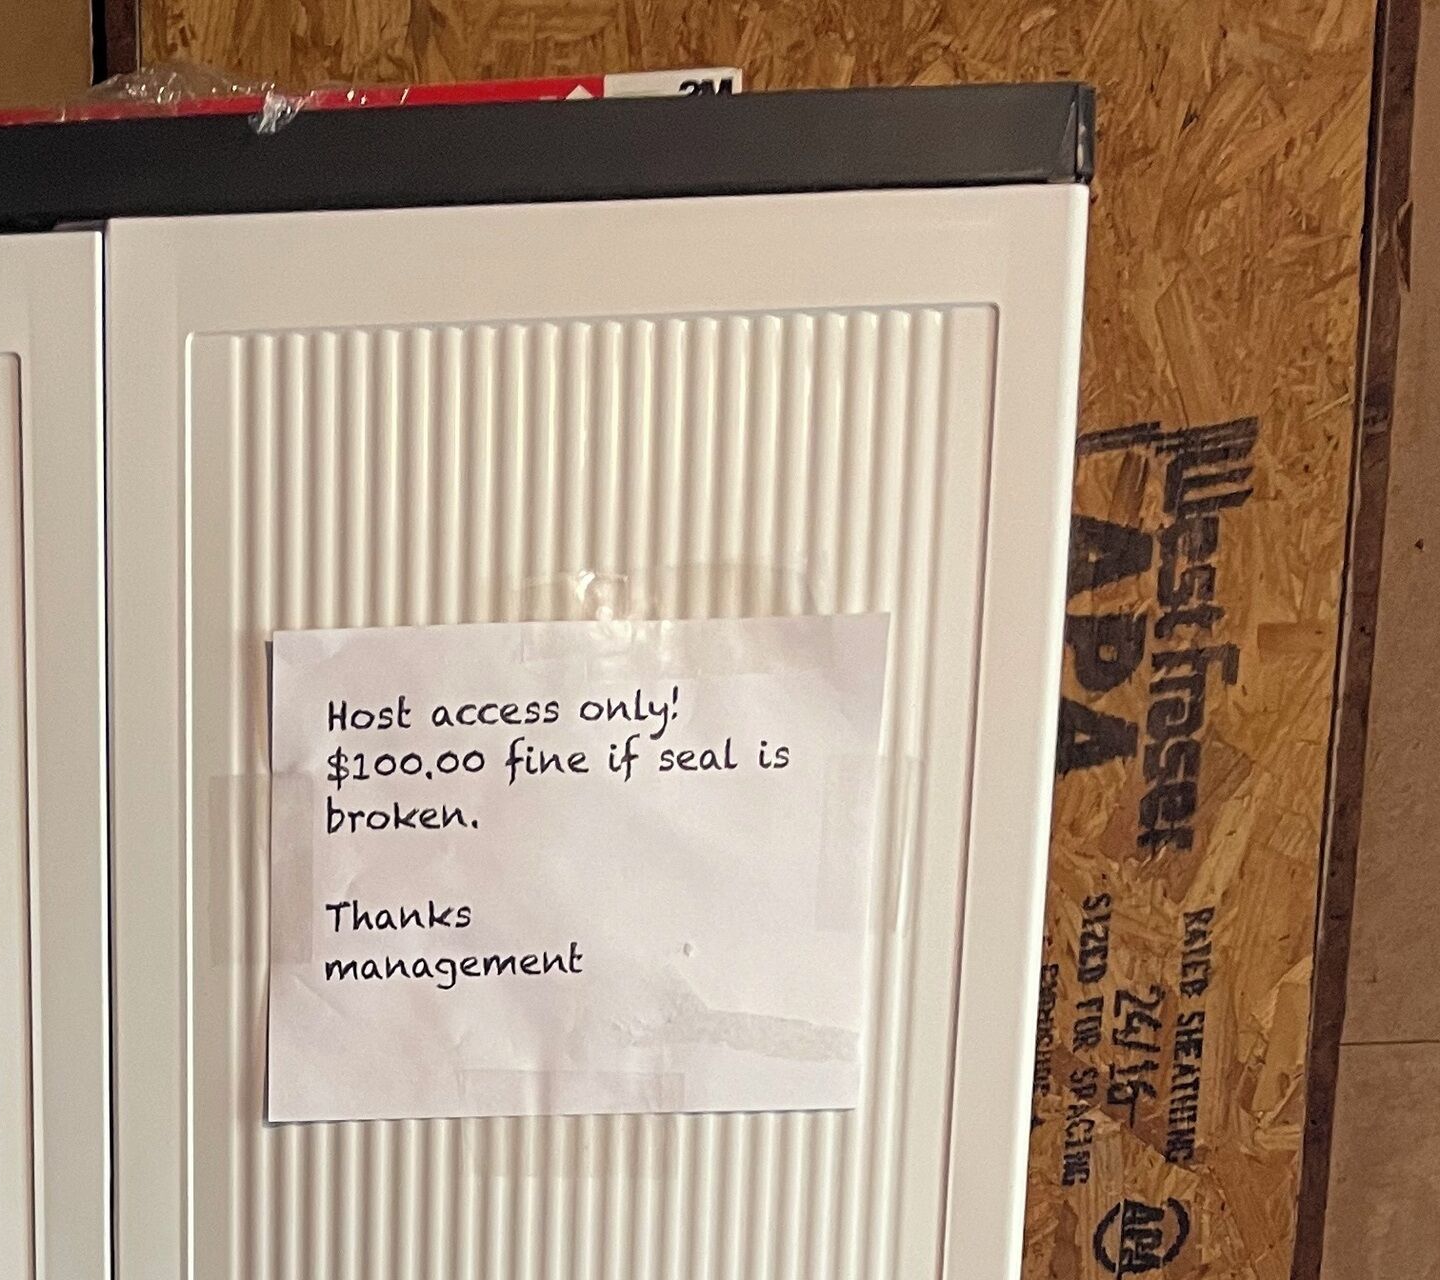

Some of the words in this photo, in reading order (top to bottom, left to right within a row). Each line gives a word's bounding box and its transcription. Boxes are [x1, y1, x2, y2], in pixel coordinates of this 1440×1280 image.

[1056, 514, 1153, 776] APA
[326, 695, 413, 732] Host
[430, 698, 560, 727] access
[578, 686, 680, 739] only!
[326, 746, 486, 790] $100.00
[504, 736, 590, 786] fine
[607, 735, 638, 783] if
[658, 738, 739, 772] seal
[756, 736, 791, 770] is
[325, 795, 481, 835] broken.
[325, 900, 473, 933] Thanks
[1076, 892, 1112, 985] SIZED
[324, 942, 585, 990] management
[1179, 906, 1215, 998] RATED
[1072, 995, 1105, 1053] FOR
[1164, 1010, 1206, 1163] SHEATHING
[1061, 1065, 1100, 1187] SPACING
[1120, 1198, 1165, 1273] APA
